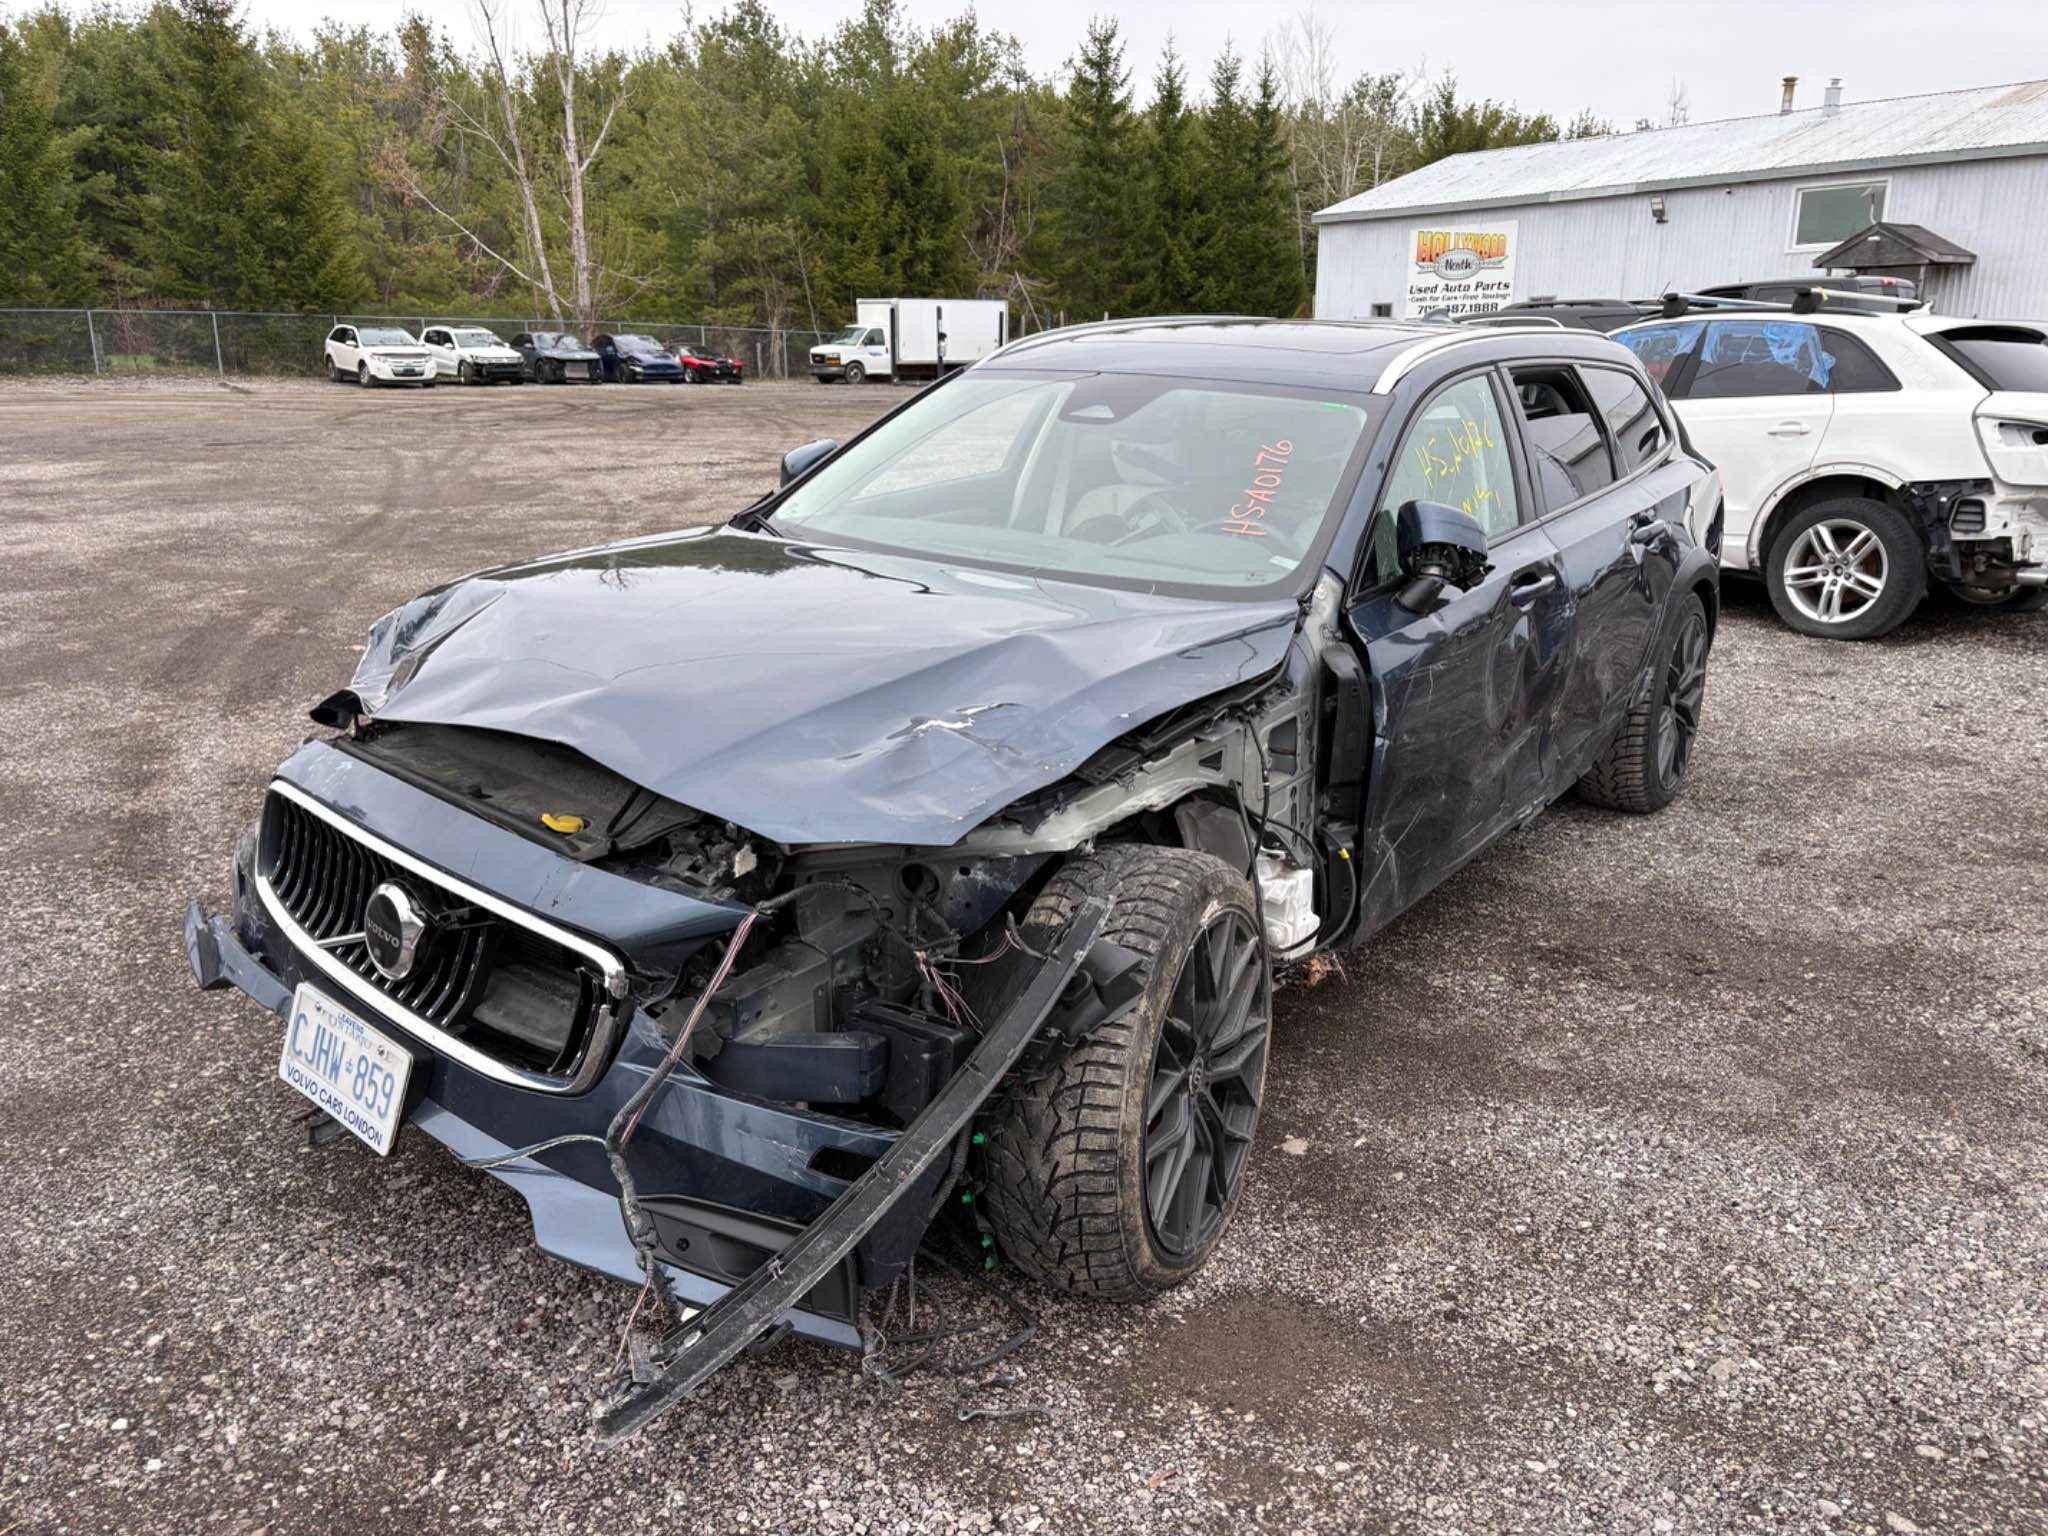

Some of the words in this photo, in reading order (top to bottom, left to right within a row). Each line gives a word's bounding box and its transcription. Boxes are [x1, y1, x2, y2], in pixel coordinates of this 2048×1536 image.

[1417, 230, 1508, 262] HOLLYWOOD
[1409, 283, 1439, 295] Used
[1441, 283, 1471, 294] Auto
[1474, 281, 1511, 292] Parts
[368, 920, 400, 948] VOLVO
[292, 1012, 346, 1084] CJHW
[352, 1055, 396, 1120] 859
[287, 1063, 318, 1096] VOLVO
[319, 1088, 344, 1115] CARS
[343, 1105, 384, 1147] LONDON
